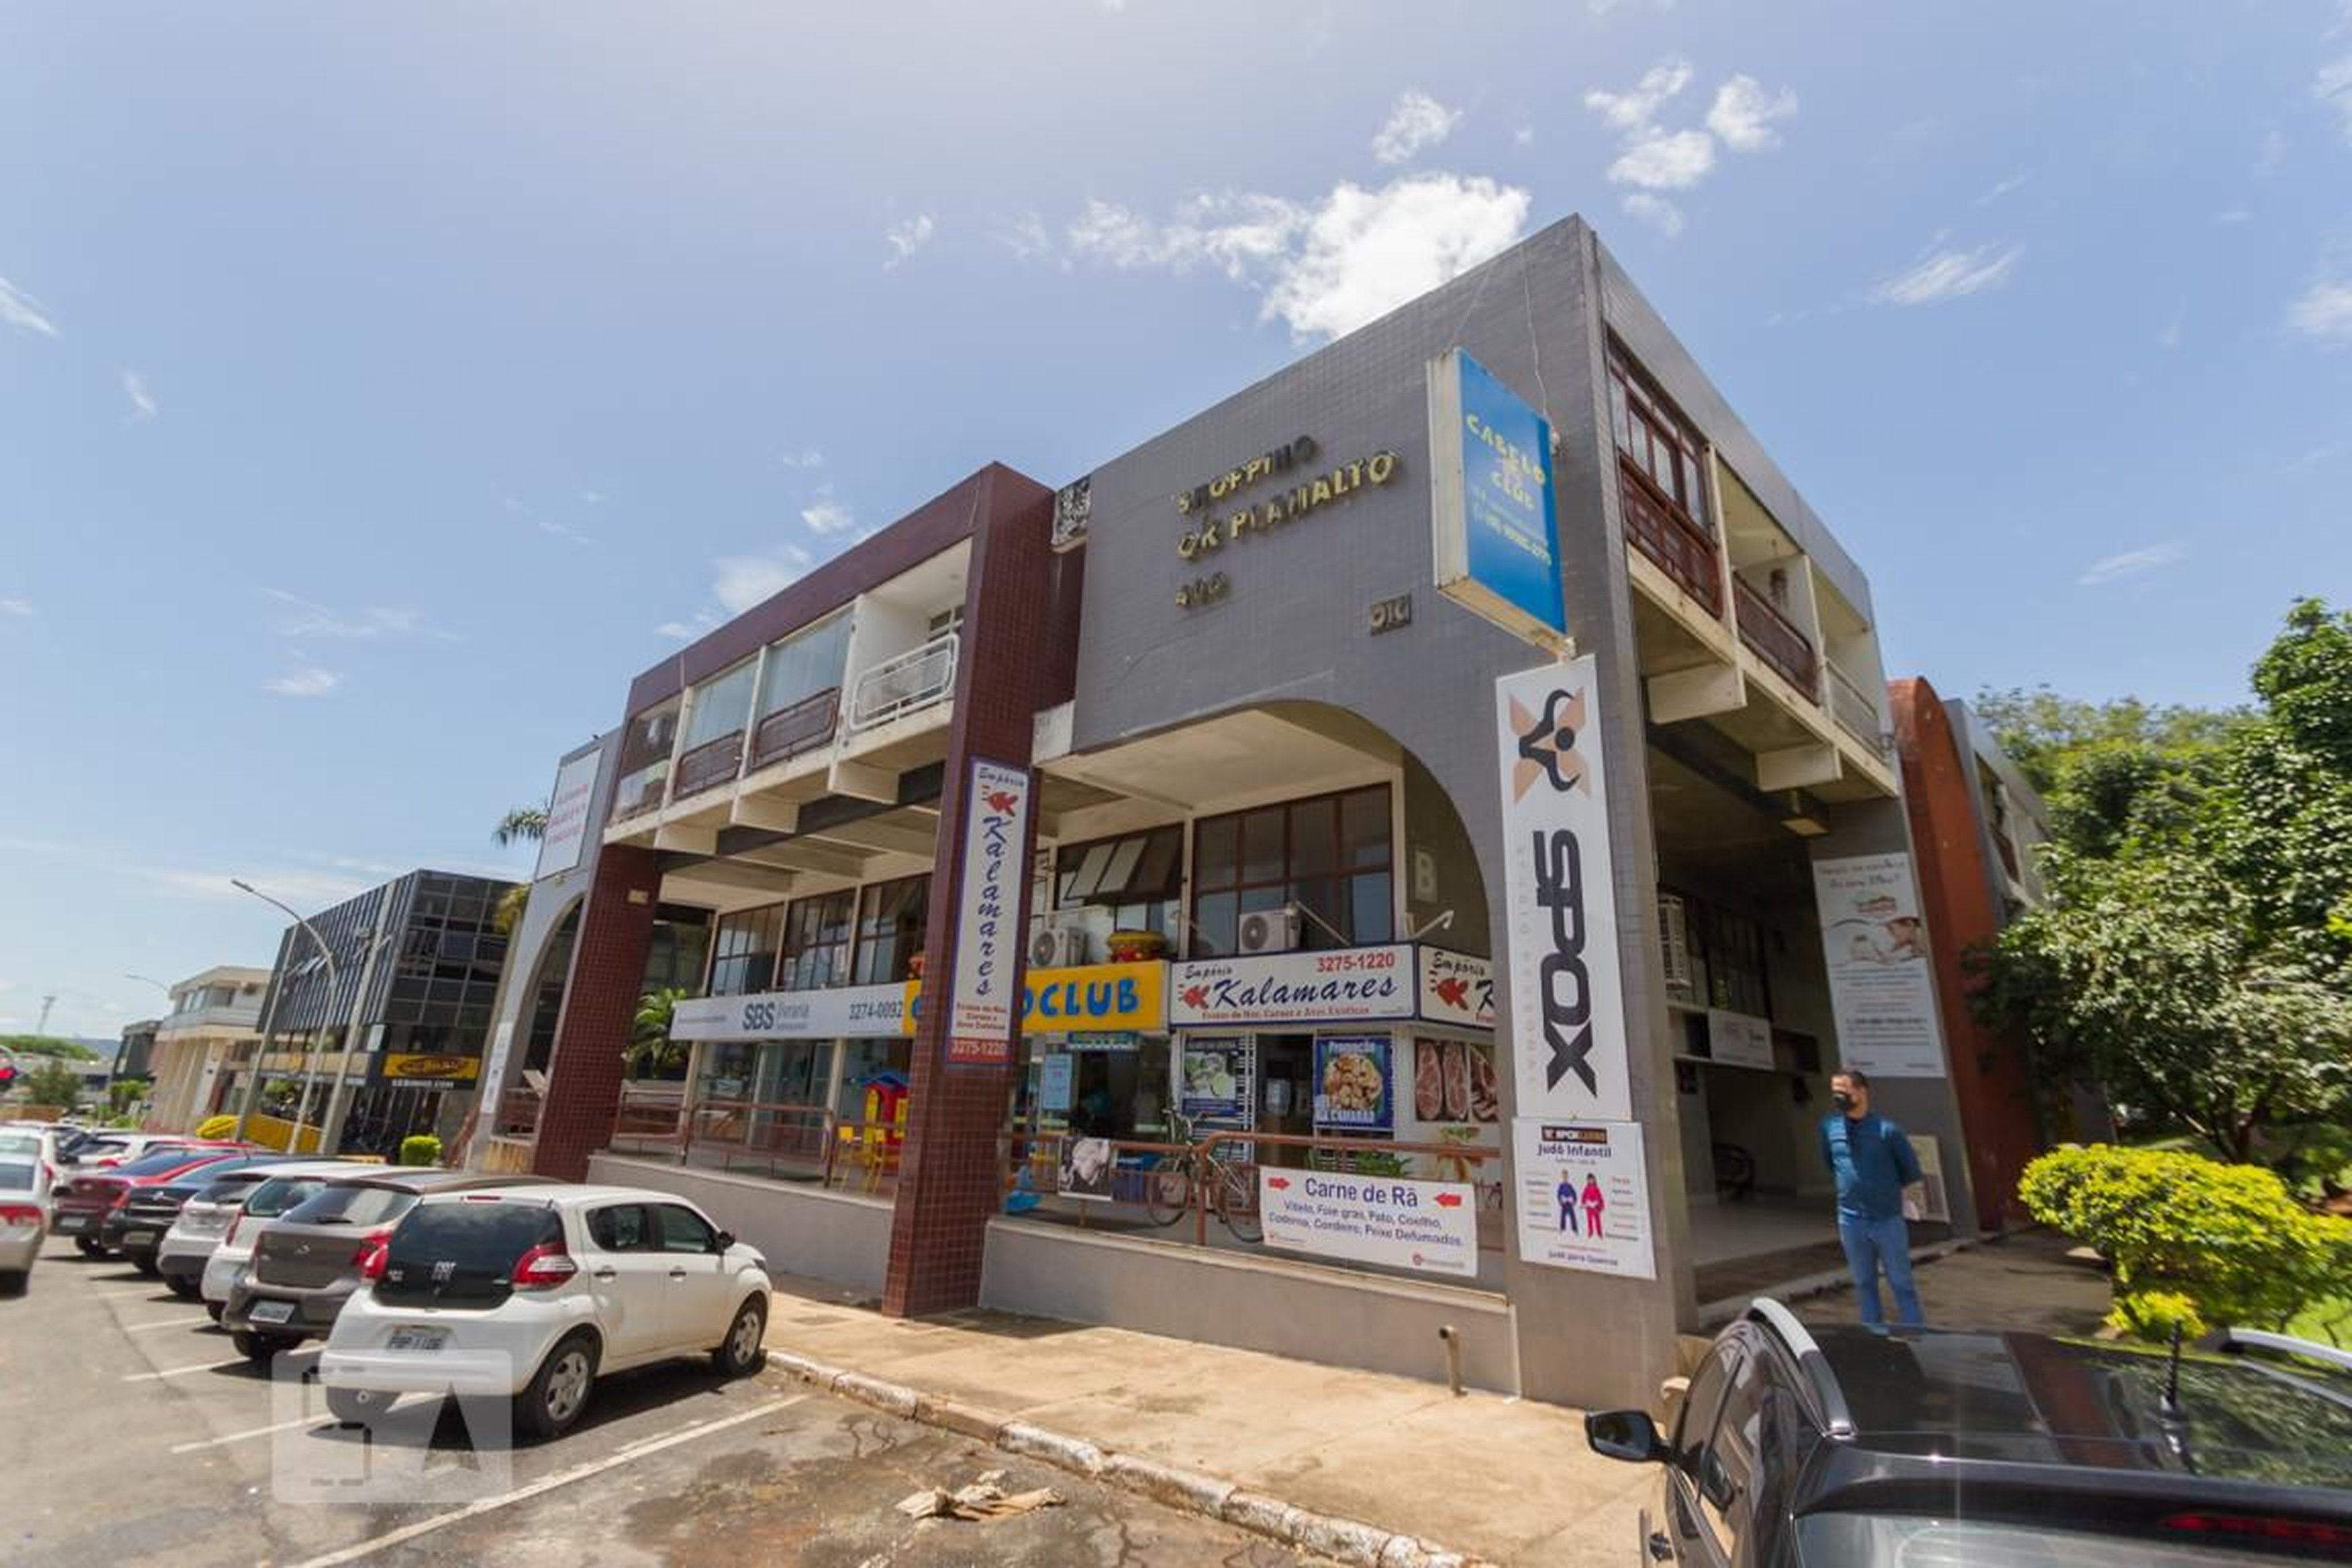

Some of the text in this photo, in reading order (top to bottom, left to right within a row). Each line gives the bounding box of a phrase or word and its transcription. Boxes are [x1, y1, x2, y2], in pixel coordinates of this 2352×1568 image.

[1317, 952, 1395, 973] 3275-1220
[1213, 975, 1398, 1009] Kalamares
[743, 1002, 775, 1030] SBS
[1305, 1177, 1418, 1208] Carne de Rã
